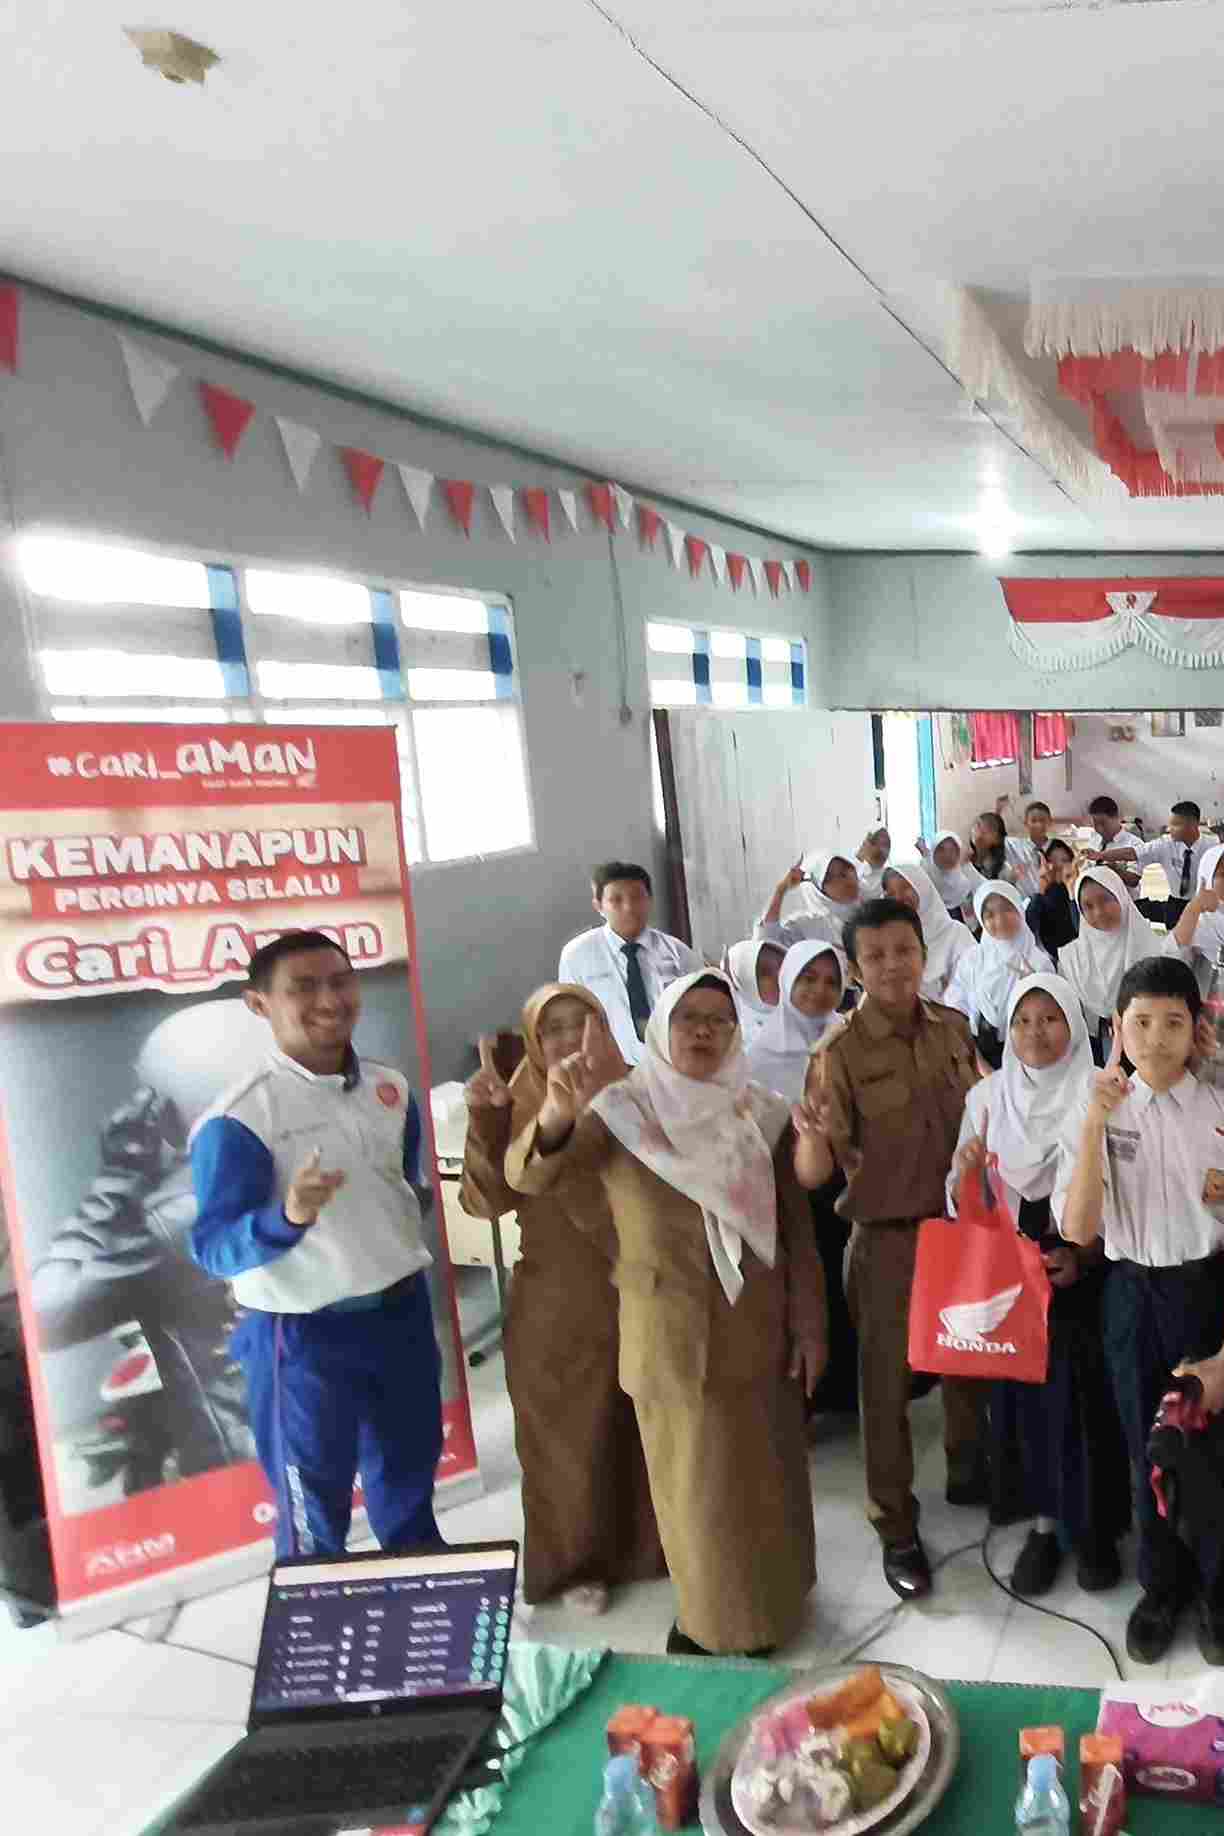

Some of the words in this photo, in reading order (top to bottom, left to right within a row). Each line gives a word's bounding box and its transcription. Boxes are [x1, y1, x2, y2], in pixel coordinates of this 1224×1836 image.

[8, 828, 362, 879] KEMANAPUN
[54, 880, 221, 912] PERGINYA
[226, 874, 341, 900] SELALU
[21, 924, 381, 986] Cari_An
[935, 1332, 1017, 1355] HONDA
